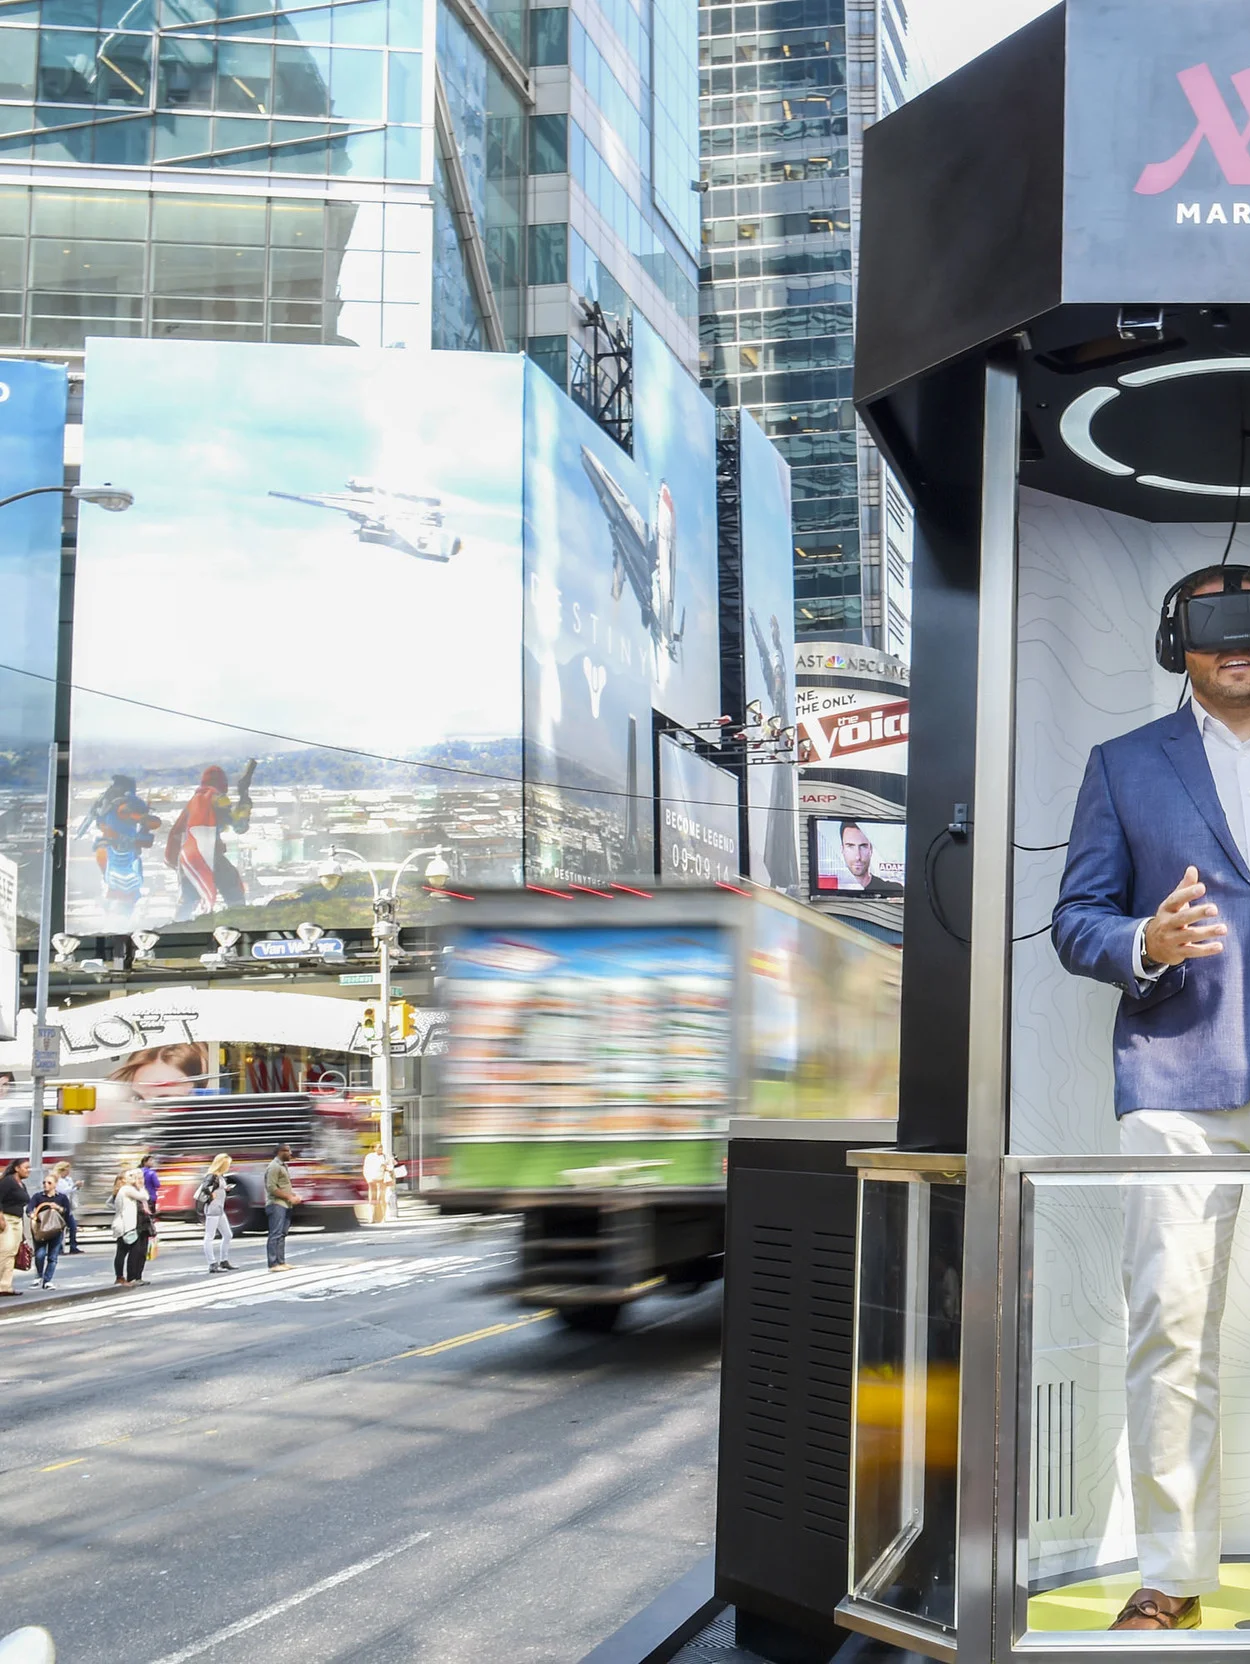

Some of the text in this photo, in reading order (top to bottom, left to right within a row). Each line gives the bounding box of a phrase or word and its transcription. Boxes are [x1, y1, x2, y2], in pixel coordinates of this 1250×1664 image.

[795, 690, 818, 703] NE.
[822, 694, 857, 709] ONLY.
[837, 715, 859, 726] the
[665, 808, 735, 853] BECOME LEGEND
[60, 1012, 199, 1054] LOFT
